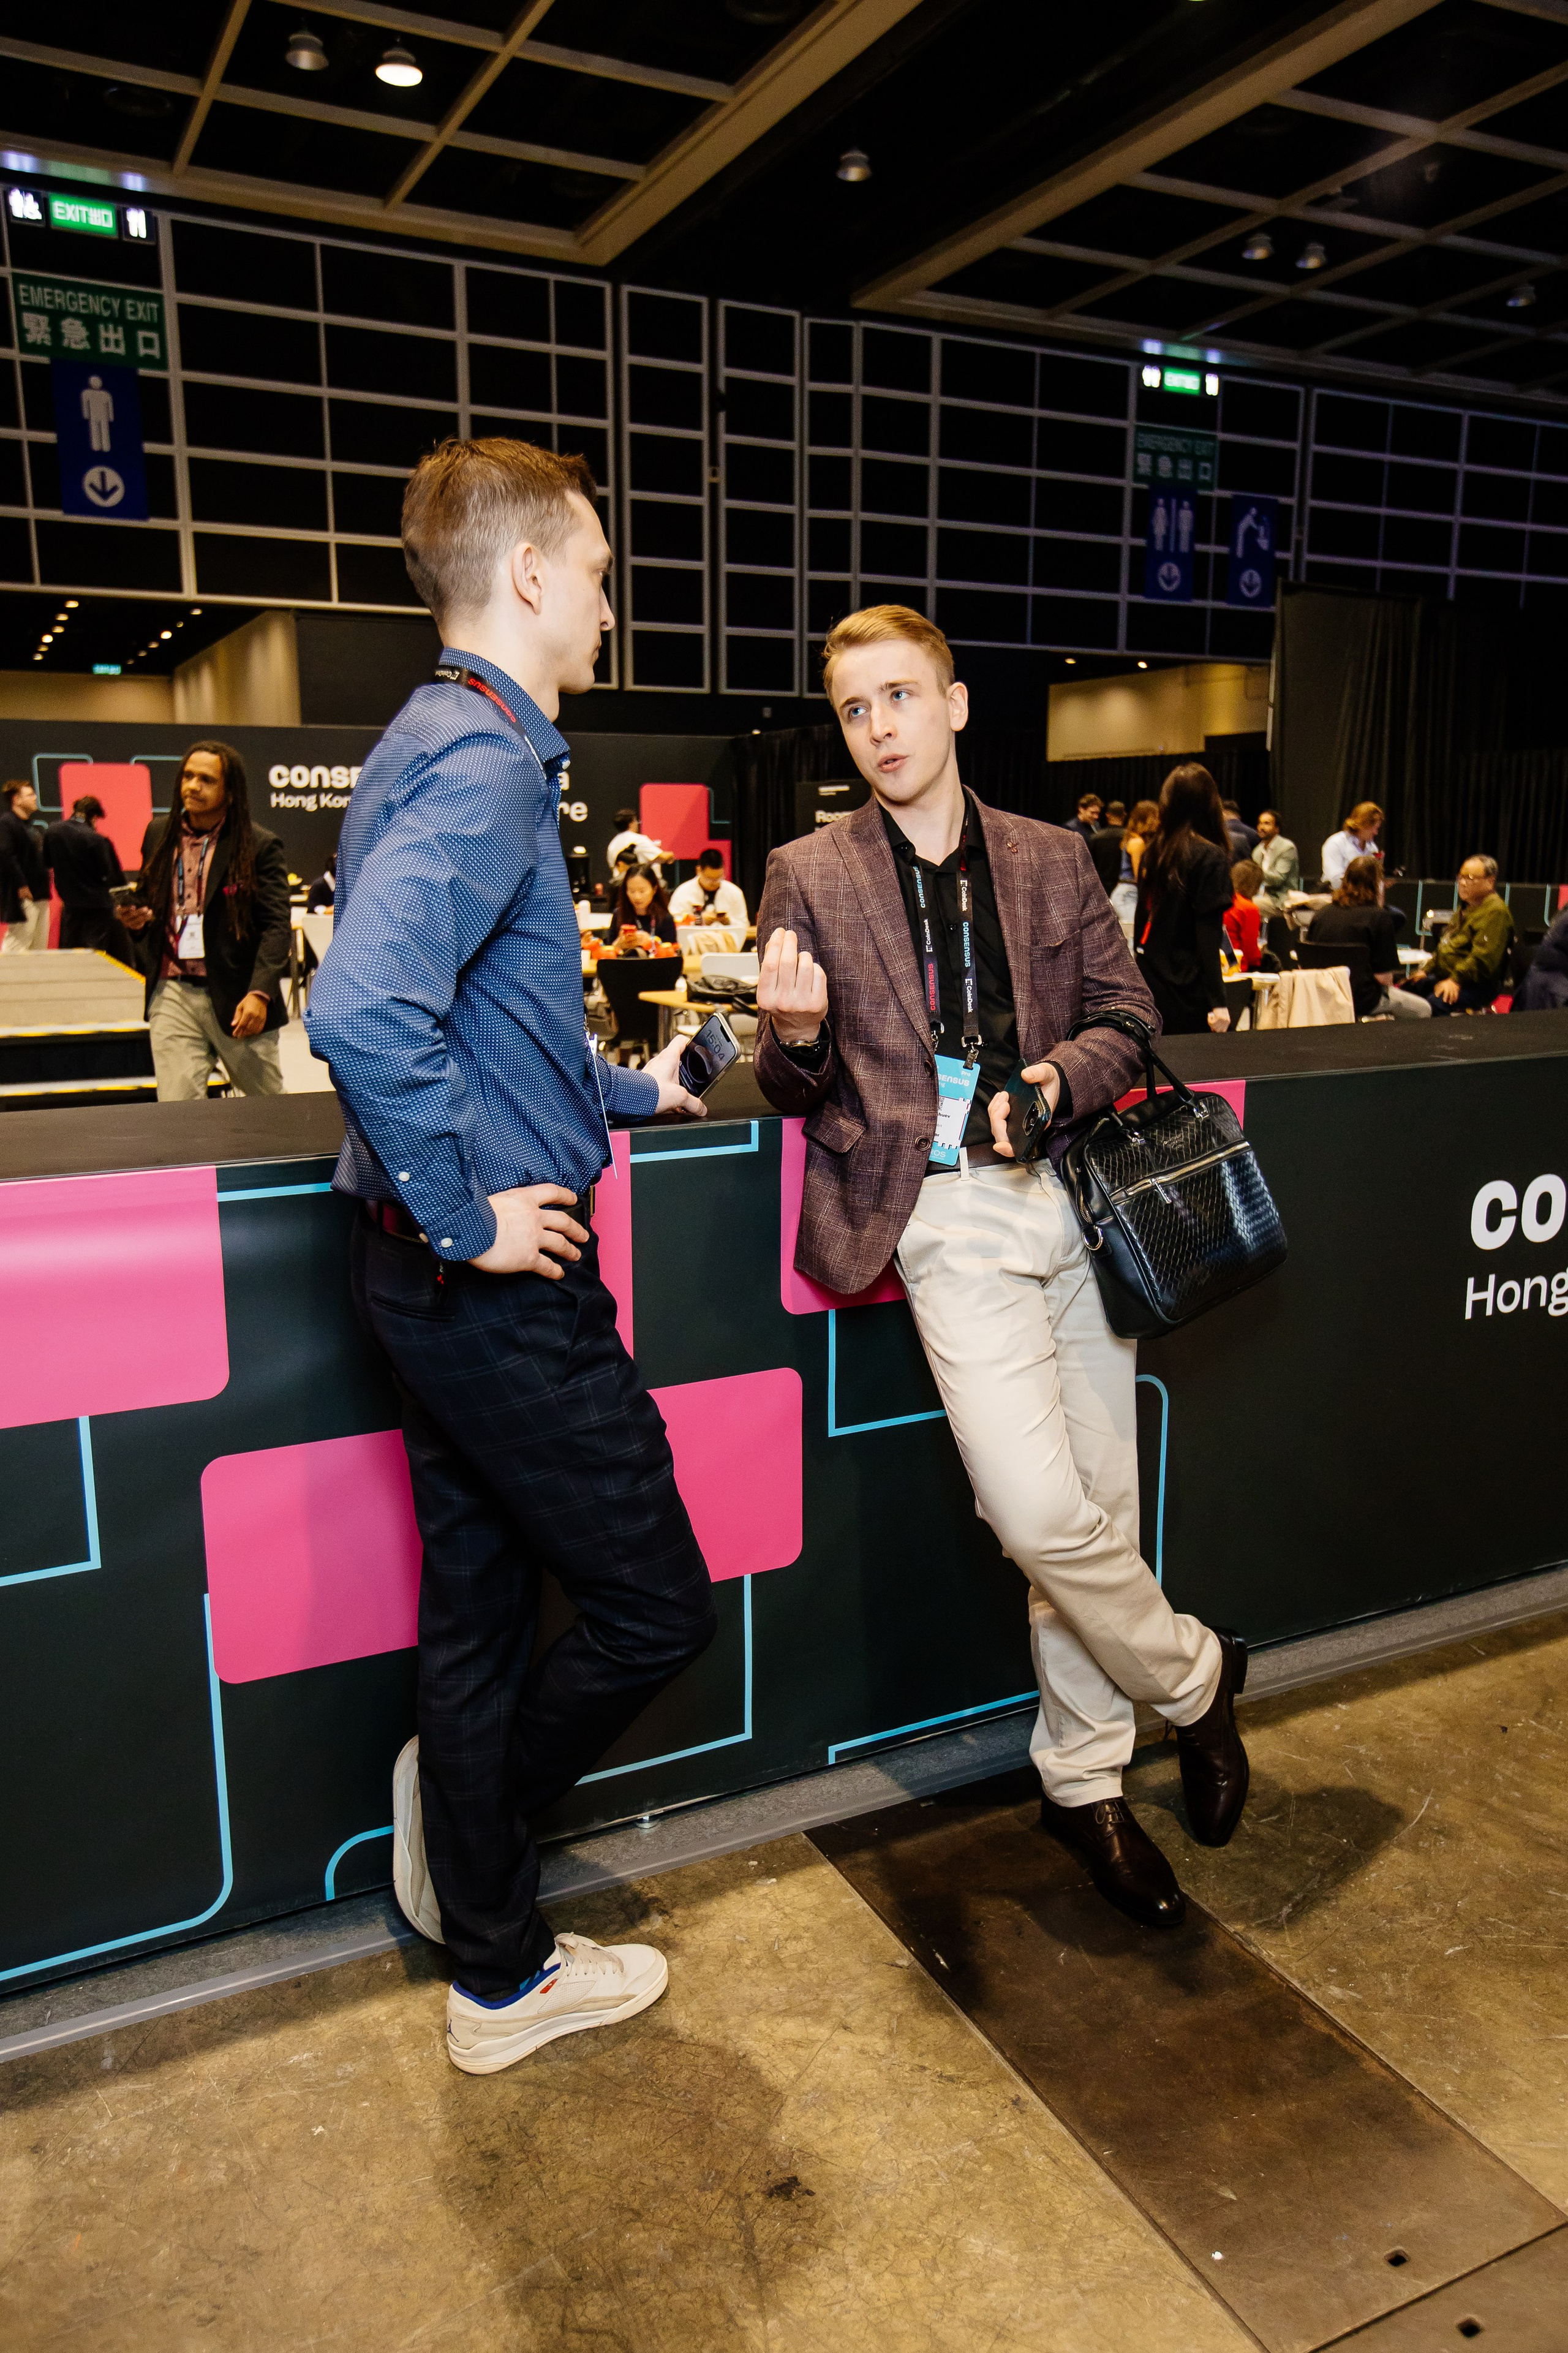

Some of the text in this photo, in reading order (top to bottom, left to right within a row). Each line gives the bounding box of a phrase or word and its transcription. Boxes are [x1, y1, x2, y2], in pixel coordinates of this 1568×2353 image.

[52, 200, 86, 223] EXIT
[19, 283, 159, 323] EMERGENCY EXIT
[271, 792, 352, 812] Hong Kon
[706, 1029, 725, 1060] 15:04
[1464, 1266, 1568, 1320] Hong
